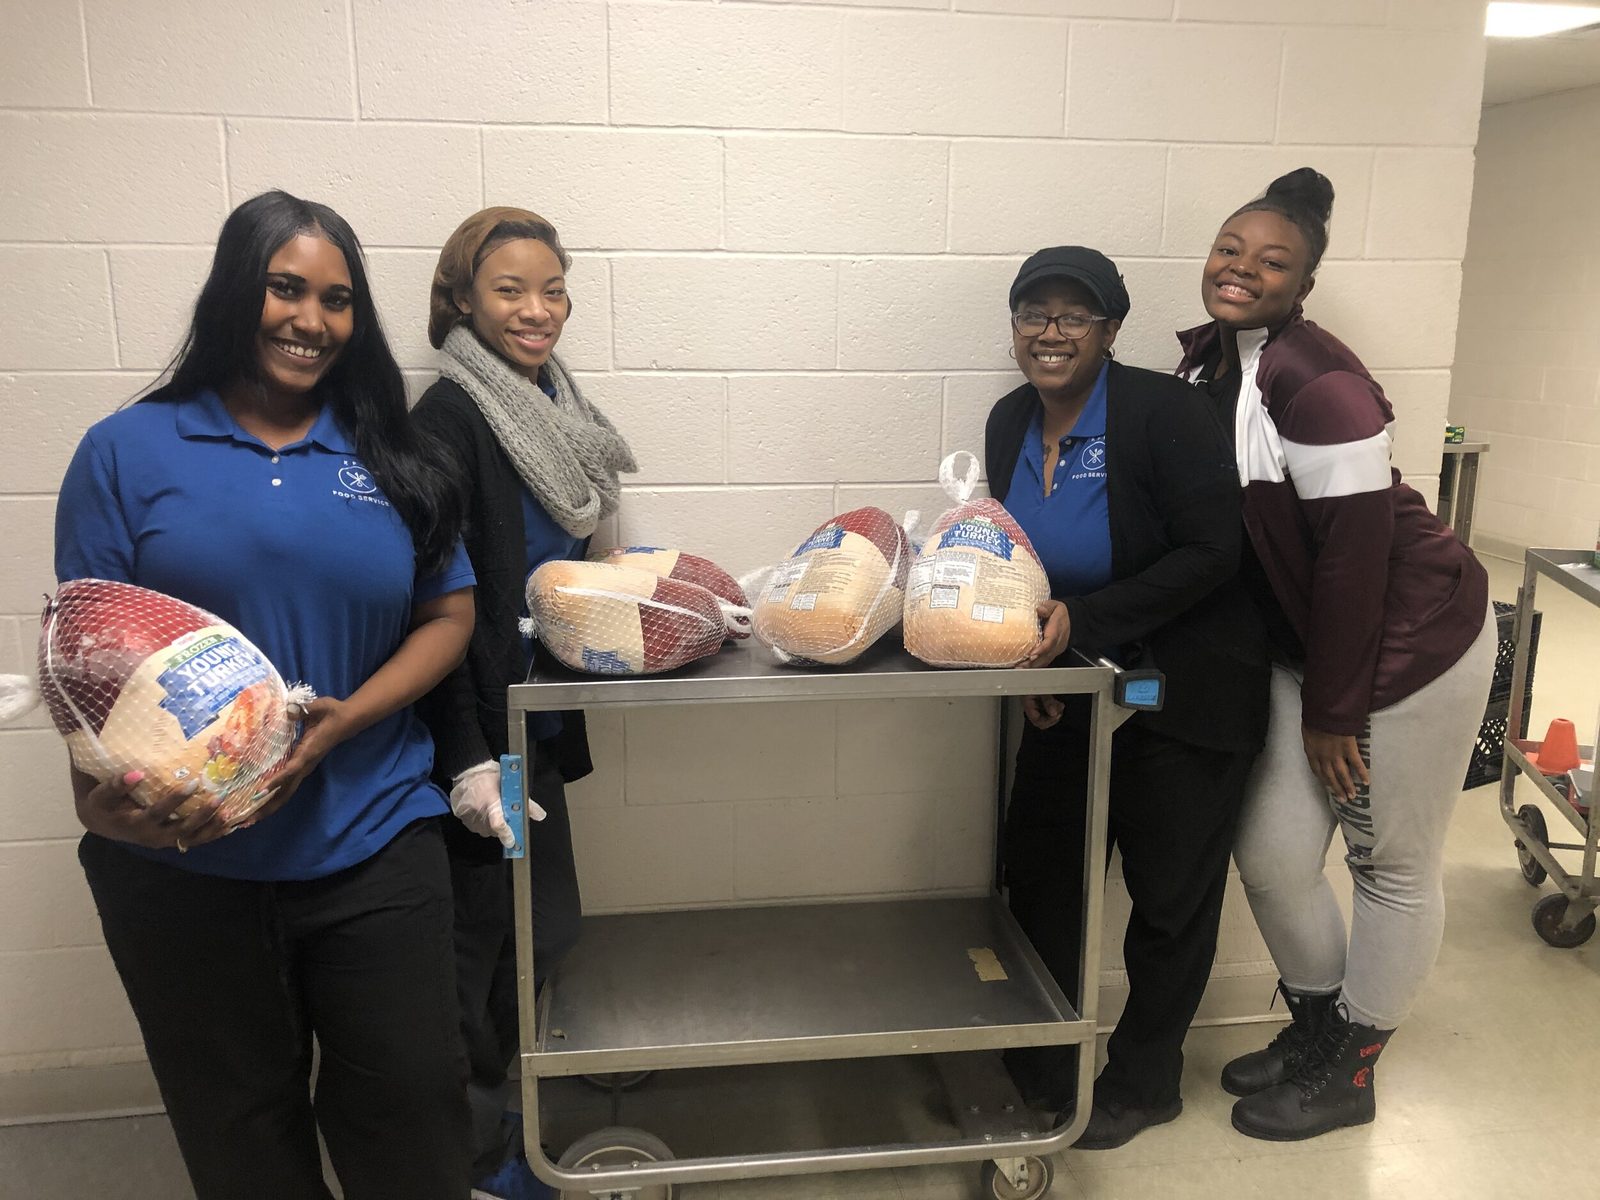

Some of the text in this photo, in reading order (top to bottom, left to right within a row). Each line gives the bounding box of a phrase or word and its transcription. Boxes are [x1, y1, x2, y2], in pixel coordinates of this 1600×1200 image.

[332, 490, 356, 500] FOOD
[954, 530, 1001, 546] TURKEY
[960, 523, 998, 539] YOUNG
[175, 636, 219, 662] FROZEN
[187, 652, 258, 697] TURKEY
